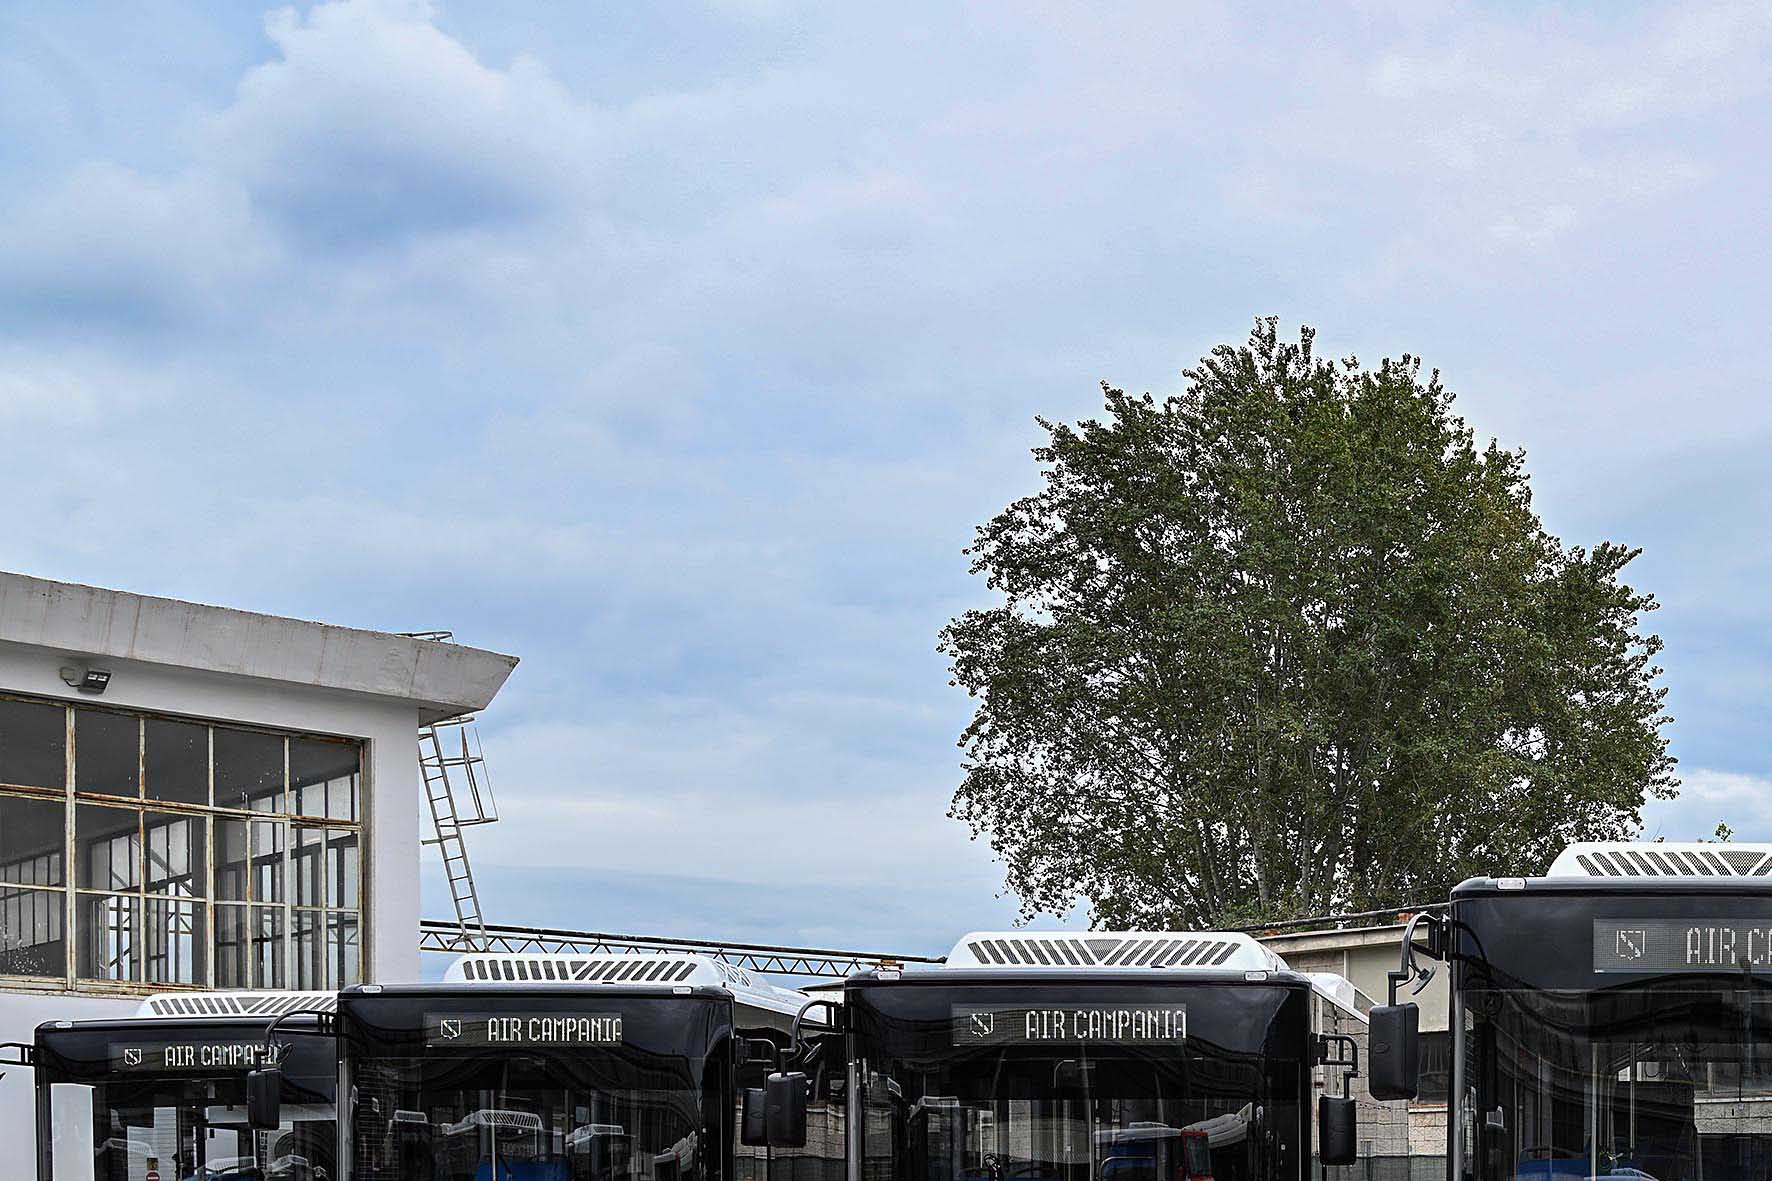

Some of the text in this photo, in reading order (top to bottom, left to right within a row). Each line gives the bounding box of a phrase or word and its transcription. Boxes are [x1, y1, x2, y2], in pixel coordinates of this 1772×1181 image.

[1686, 927, 1736, 965] AIR
[488, 1017, 623, 1042] AIR CAMPANIA
[1025, 1010, 1187, 1039] AIR CAMPANIA
[165, 1045, 195, 1067] AIR
